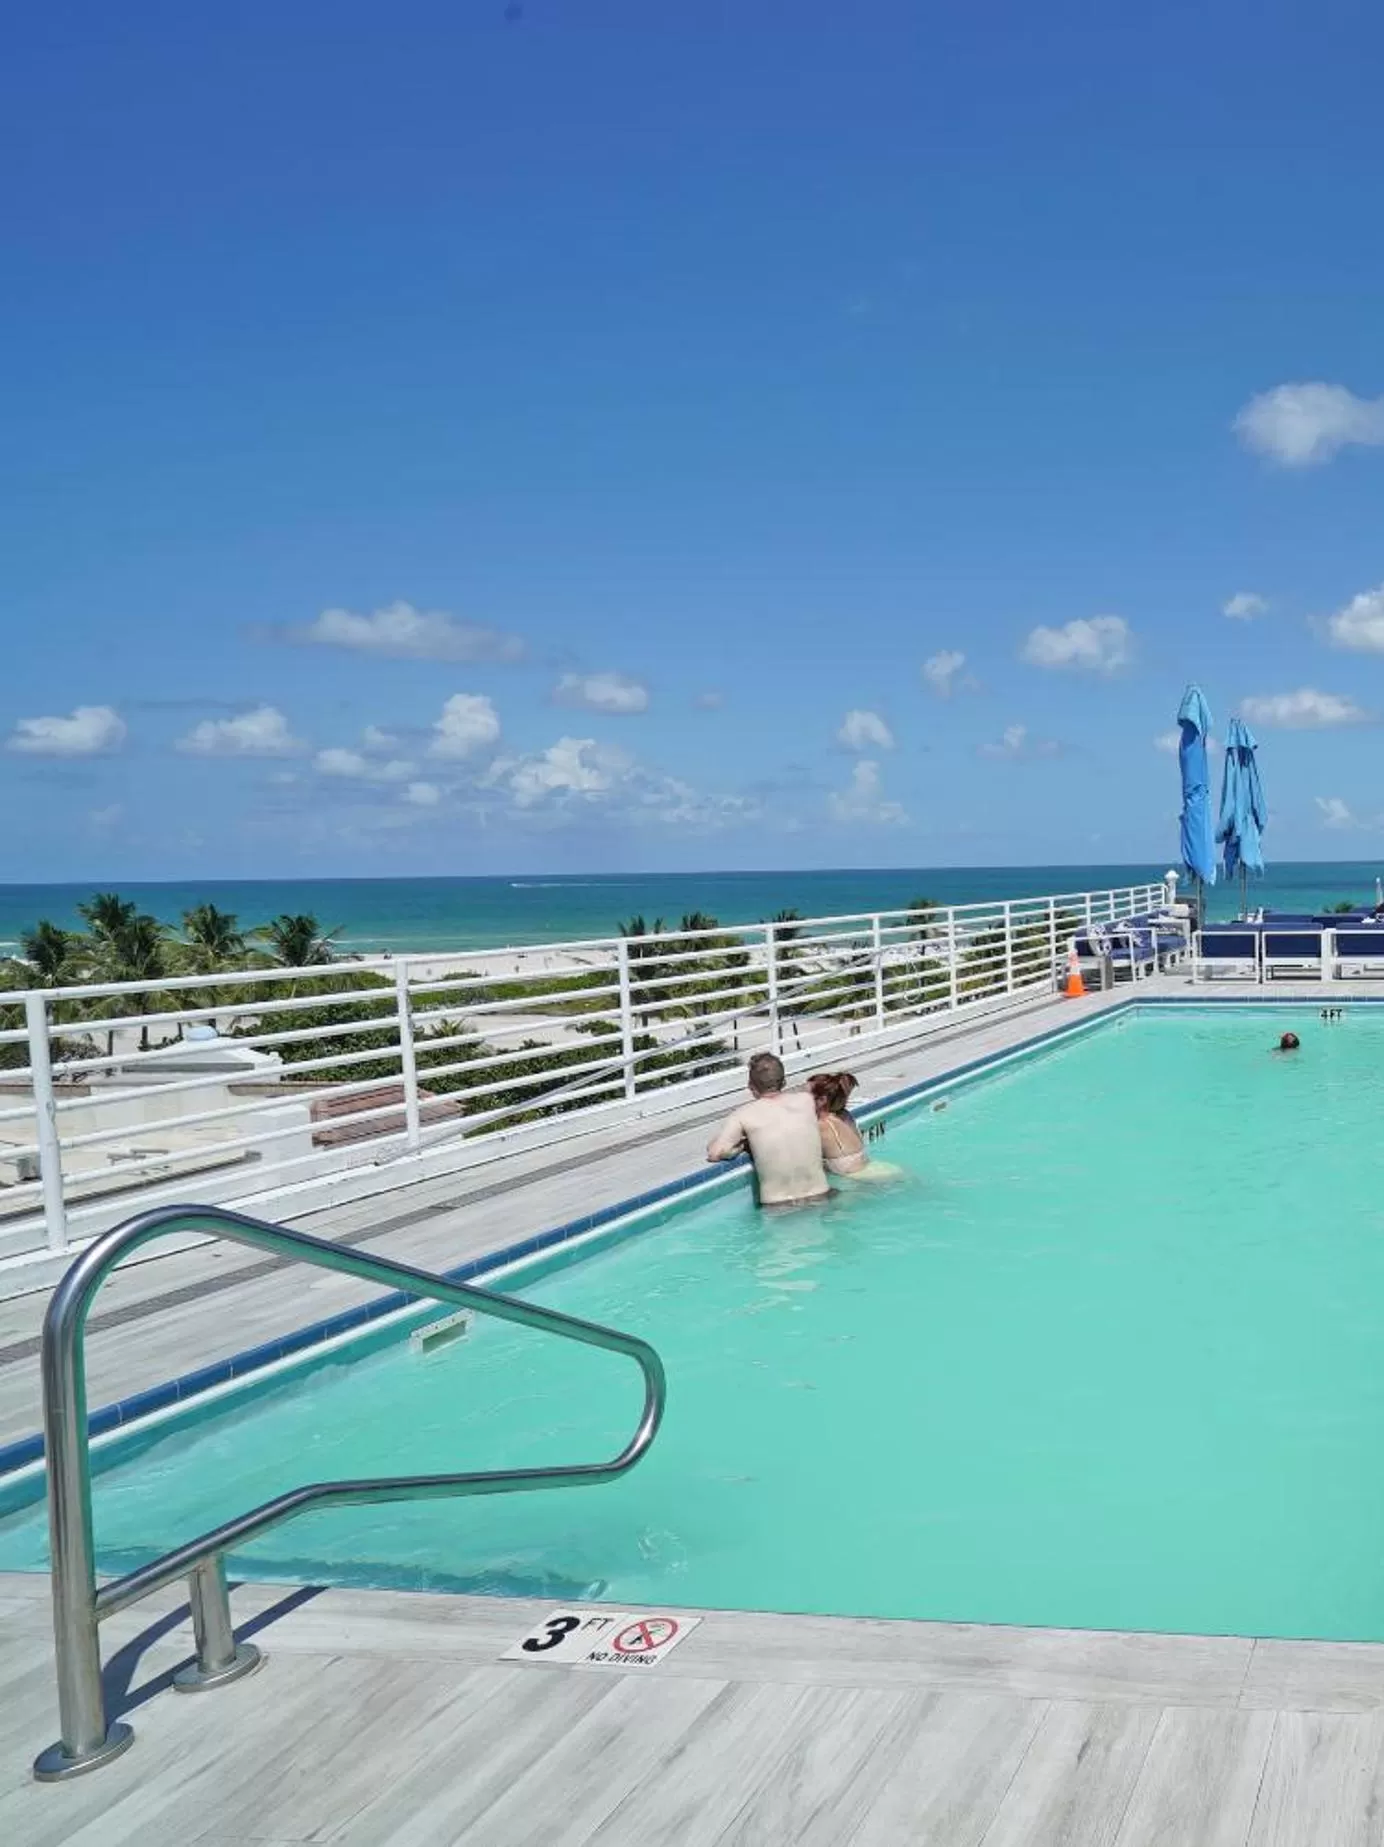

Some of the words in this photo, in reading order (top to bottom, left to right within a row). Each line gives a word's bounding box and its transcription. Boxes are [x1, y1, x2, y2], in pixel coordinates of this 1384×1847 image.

[522, 1616, 580, 1652] 3
[581, 1617, 614, 1631] FT
[586, 1652, 608, 1661] NO
[609, 1652, 657, 1664] DIVING
